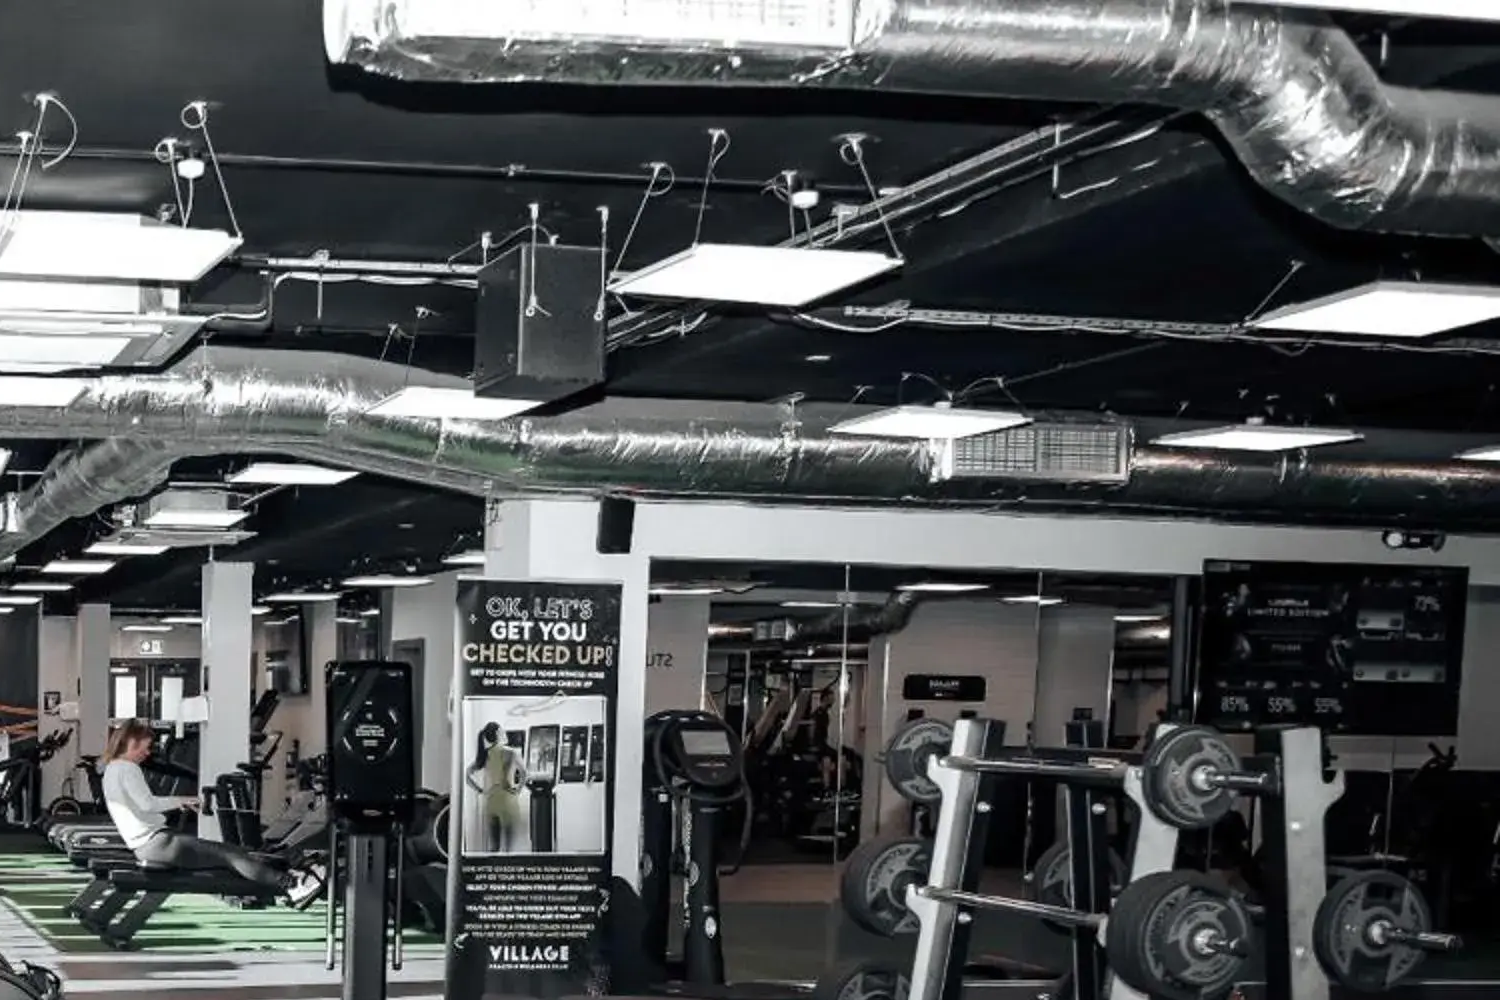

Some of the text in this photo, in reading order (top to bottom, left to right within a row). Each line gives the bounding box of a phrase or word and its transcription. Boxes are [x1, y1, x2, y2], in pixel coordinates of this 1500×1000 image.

[485, 596, 594, 621] OK, LET'S
[490, 620, 587, 642] GET YOU
[462, 643, 613, 667] CHECKED UP!
[489, 945, 569, 962] VILLAGE
